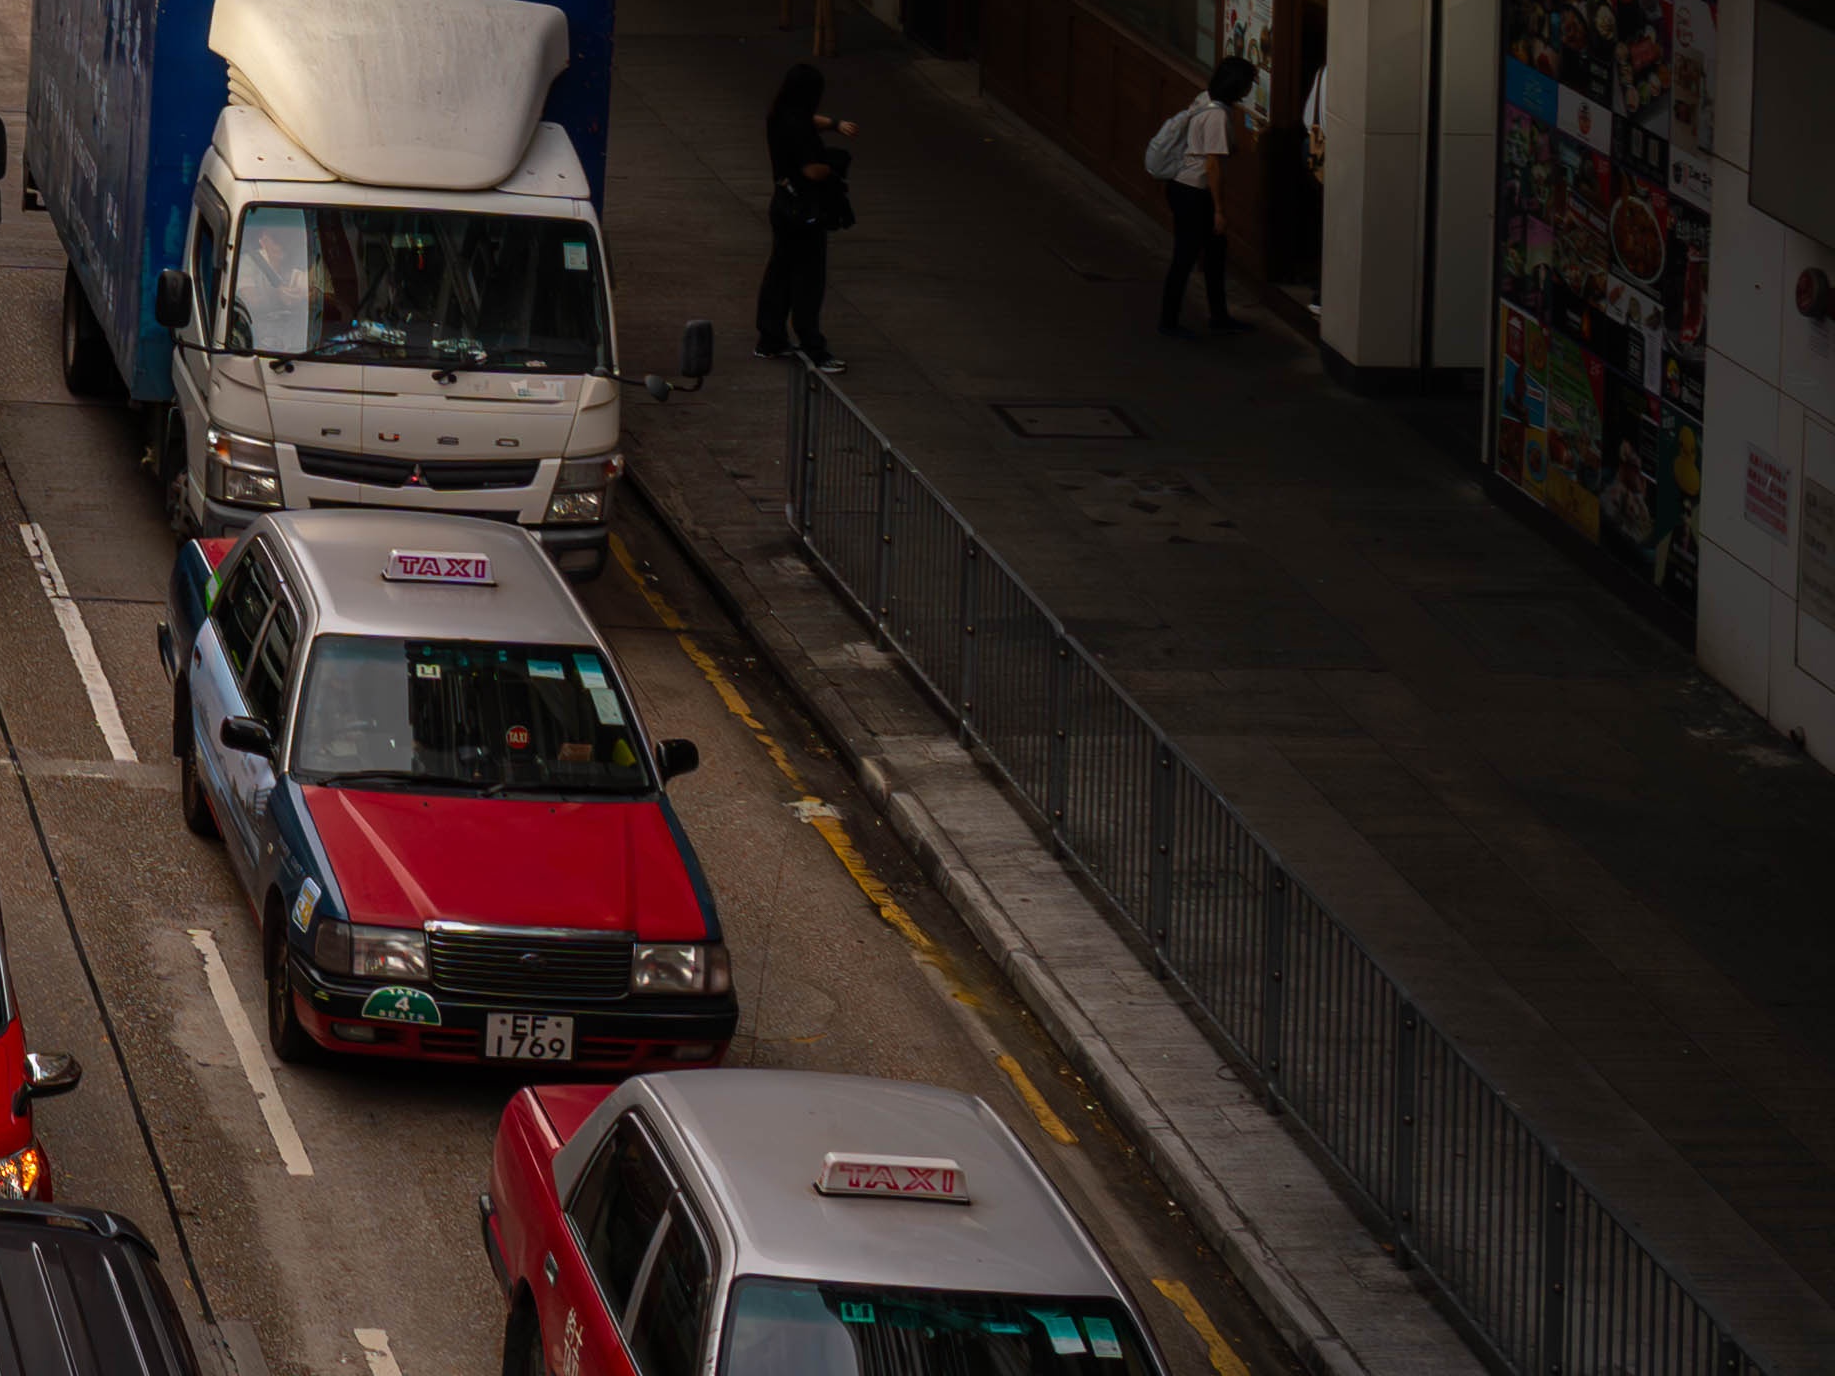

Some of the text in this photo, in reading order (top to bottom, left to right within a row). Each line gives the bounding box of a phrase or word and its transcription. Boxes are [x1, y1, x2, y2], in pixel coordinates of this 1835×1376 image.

[320, 427, 521, 447] FUSO
[397, 554, 488, 579] TAXI
[508, 732, 528, 744] TAXI
[396, 997, 411, 1011] 4
[511, 1015, 547, 1036] EF
[494, 1034, 566, 1059] 1769
[837, 1163, 957, 1193] TAXI
